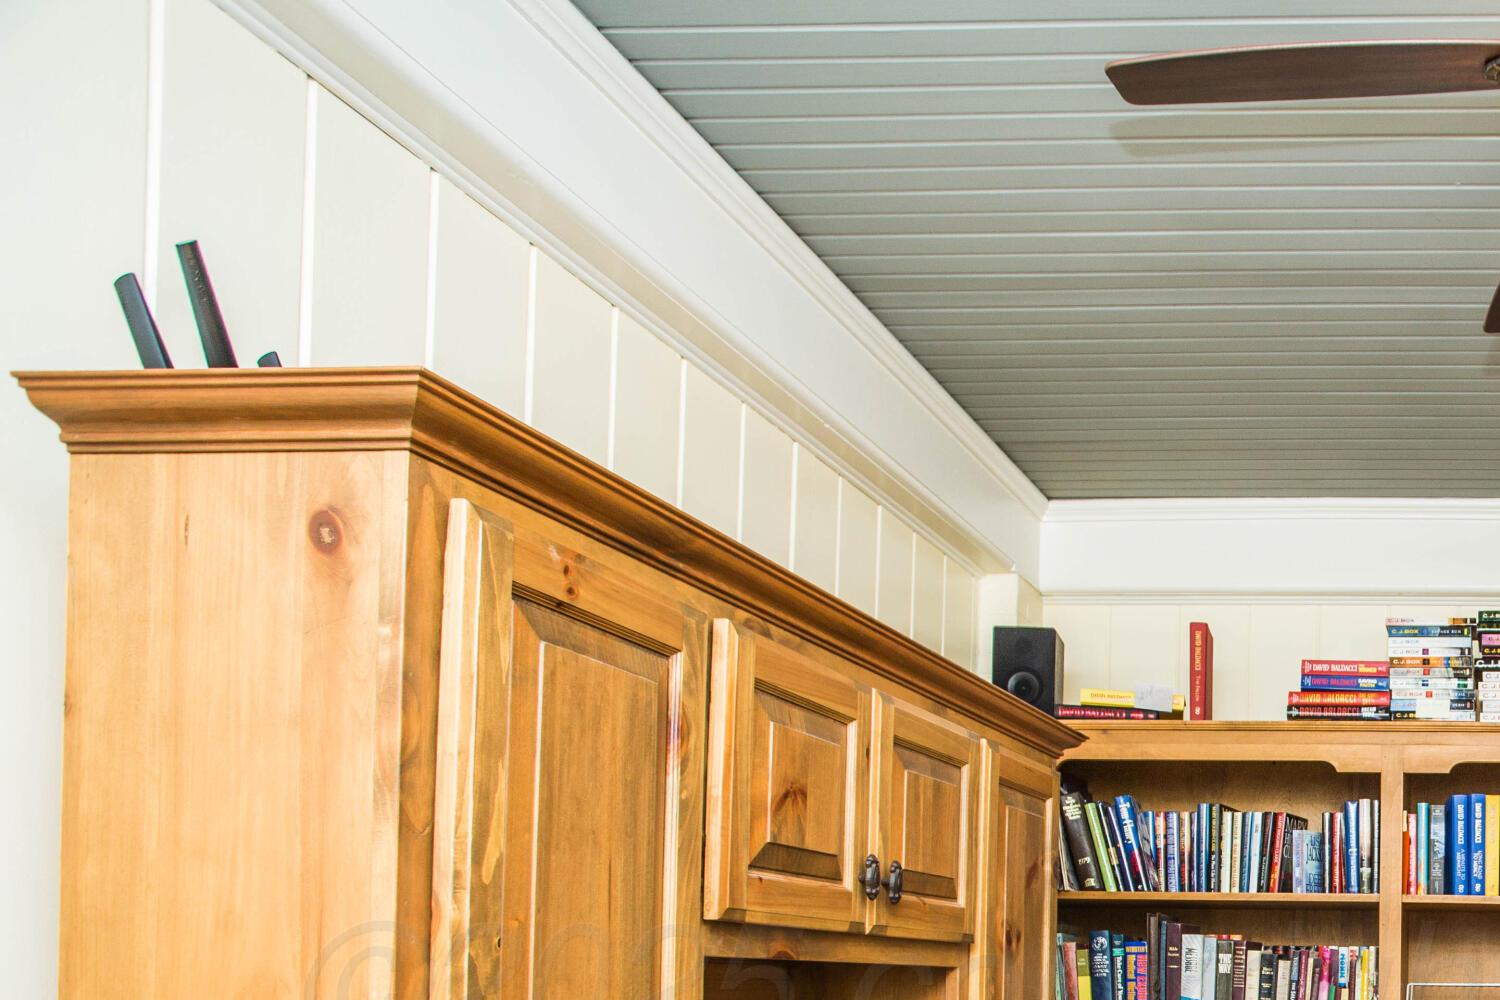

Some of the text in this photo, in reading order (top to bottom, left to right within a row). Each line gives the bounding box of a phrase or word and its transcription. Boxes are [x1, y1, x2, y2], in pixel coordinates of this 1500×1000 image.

[1331, 664, 1358, 672] BALDACCI
[1330, 678, 1357, 686] BALDACCI
[1300, 694, 1320, 703] DAVID
[1323, 694, 1357, 703] BALDACCI
[1300, 707, 1360, 716] DAVID BALDACCI
[1219, 954, 1232, 964] THE
[1218, 964, 1231, 974] WAY
